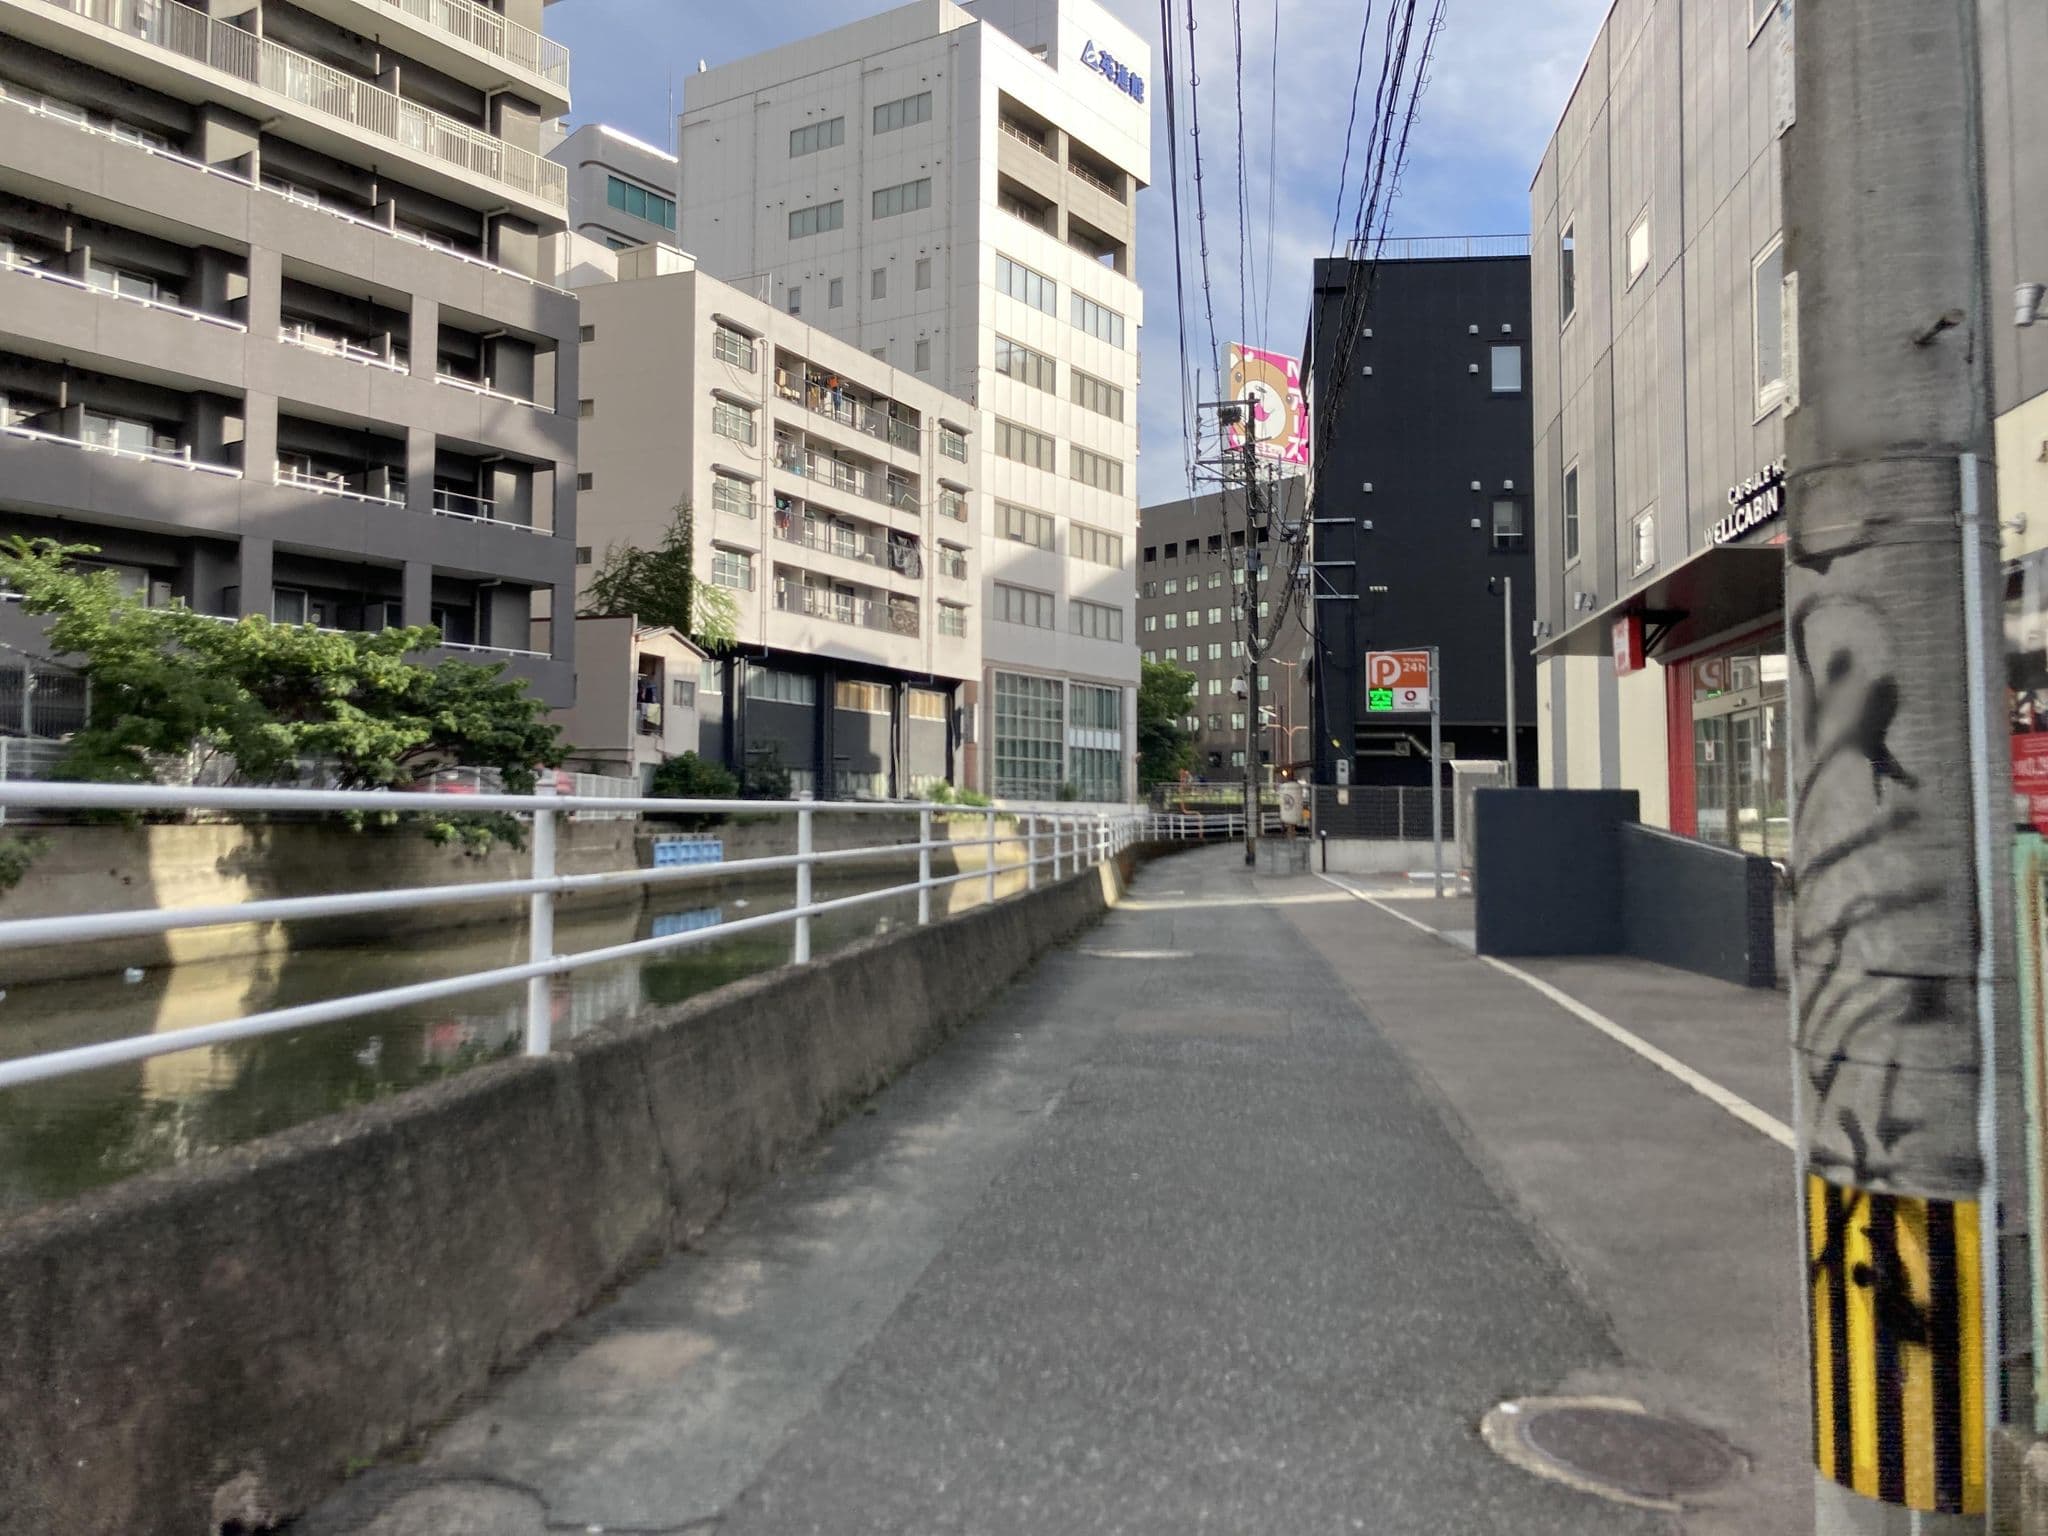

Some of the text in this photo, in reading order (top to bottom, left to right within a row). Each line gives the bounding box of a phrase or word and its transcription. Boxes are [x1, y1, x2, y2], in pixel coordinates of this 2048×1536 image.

[1727, 464, 1771, 505] CAPSULE
[1704, 486, 1779, 546] WELLCABIN
[1371, 655, 1402, 686] P
[1402, 662, 1426, 673] 24h
